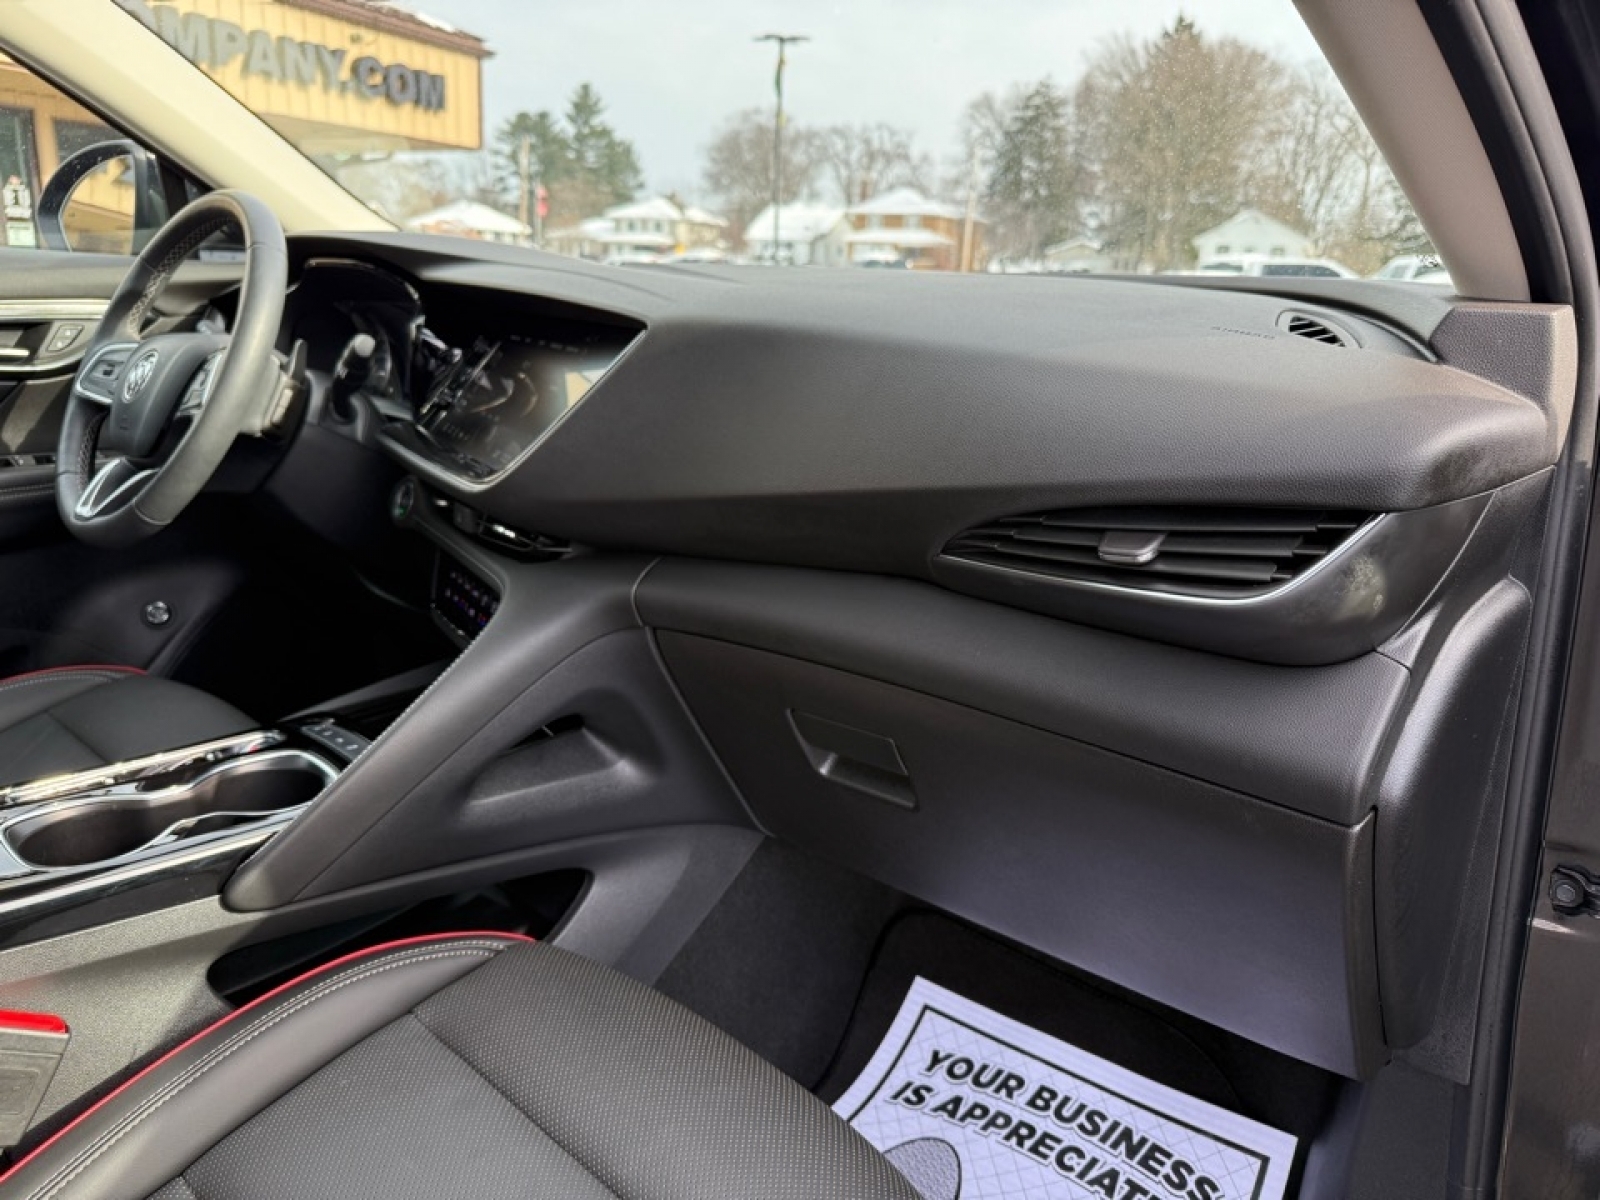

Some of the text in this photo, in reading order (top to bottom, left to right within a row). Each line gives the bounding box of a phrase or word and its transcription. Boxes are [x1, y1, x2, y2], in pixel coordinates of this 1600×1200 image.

[890, 1080, 1161, 1200] IS APPRECIAT
[924, 1049, 1221, 1200] YOUR BUSINESS
